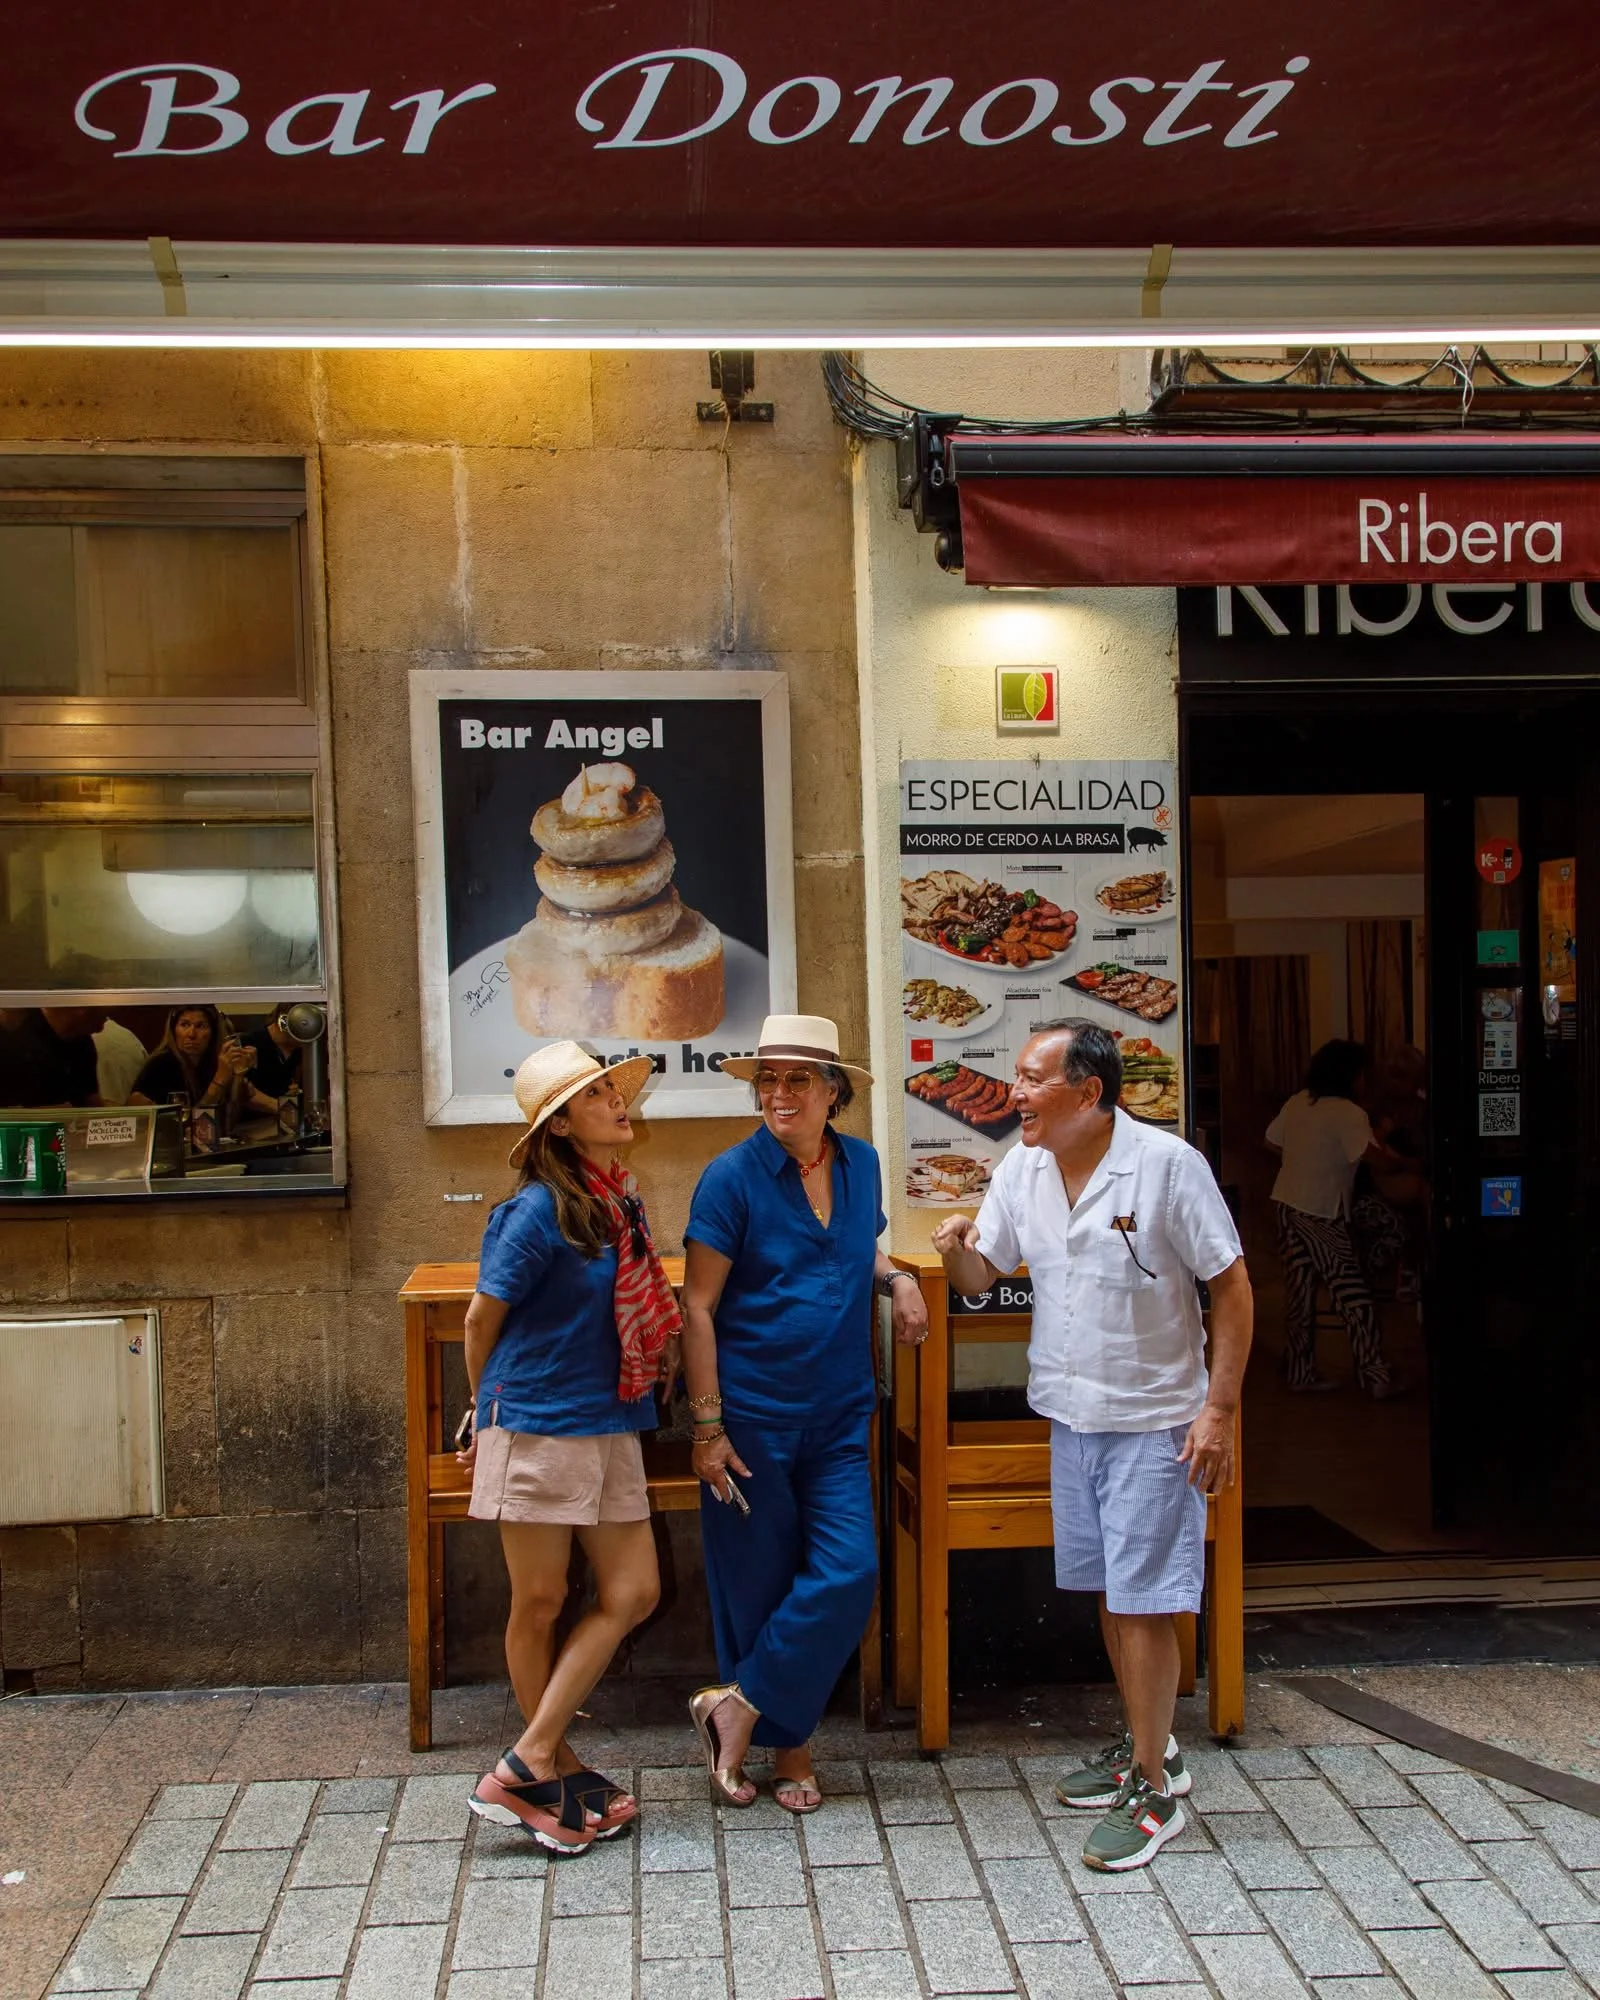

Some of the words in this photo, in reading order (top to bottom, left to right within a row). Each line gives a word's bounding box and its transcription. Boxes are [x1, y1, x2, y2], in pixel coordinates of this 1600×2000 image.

[75, 64, 496, 157] Bar
[576, 48, 1310, 148] Donosti
[1359, 493, 1562, 564] Ribera
[460, 719, 532, 749] Bar
[544, 717, 664, 757] Angel
[908, 779, 1165, 811] ESPECIALIDAD
[906, 833, 962, 847] MORRO
[965, 833, 984, 846] DE
[987, 833, 1039, 846] CERDO
[1041, 833, 1052, 846] A
[1055, 833, 1073, 846] LA
[1076, 832, 1120, 846] BRASA
[1478, 1071, 1522, 1085] Ribera
